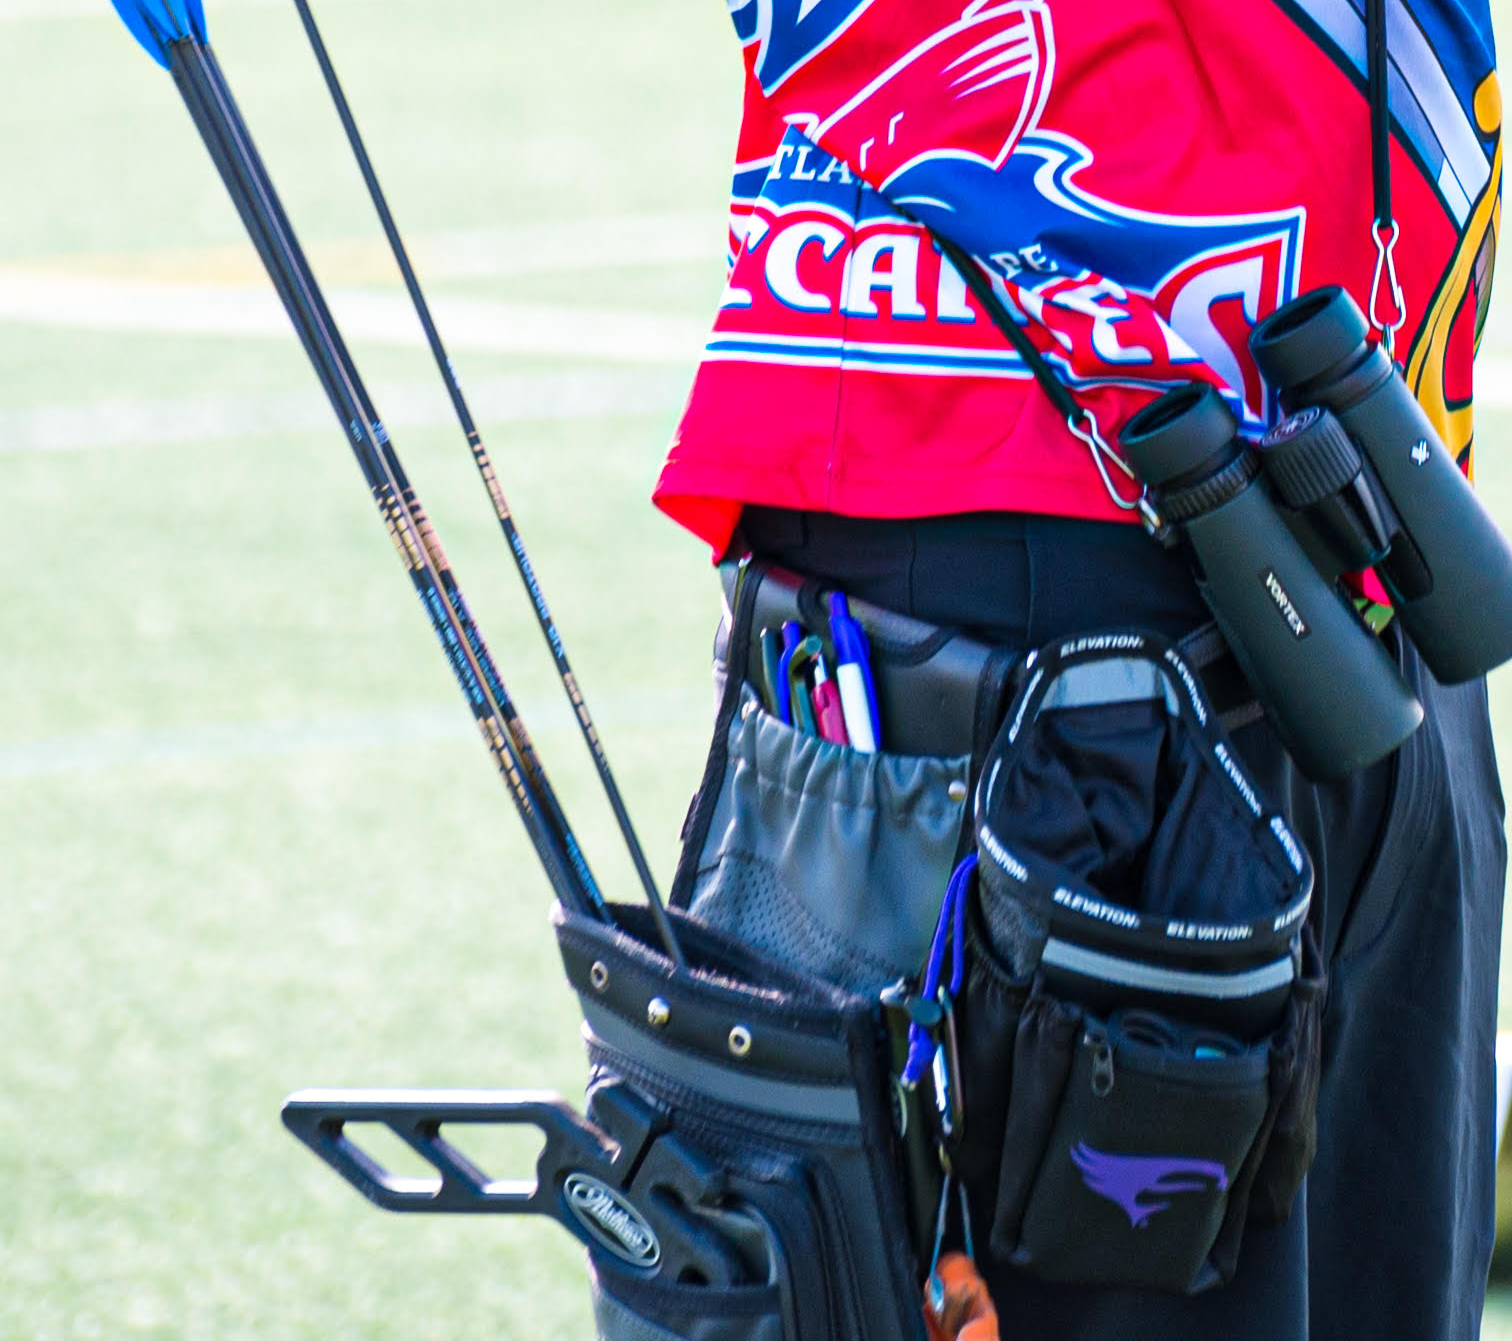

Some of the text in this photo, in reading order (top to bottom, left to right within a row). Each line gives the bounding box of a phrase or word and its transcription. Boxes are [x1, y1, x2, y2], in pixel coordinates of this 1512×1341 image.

[1266, 571, 1305, 636] VORTEX
[1060, 635, 1145, 659] ELEVATION
[1053, 886, 1141, 930] ELEVATION
[1166, 921, 1253, 942] ELEVATION
